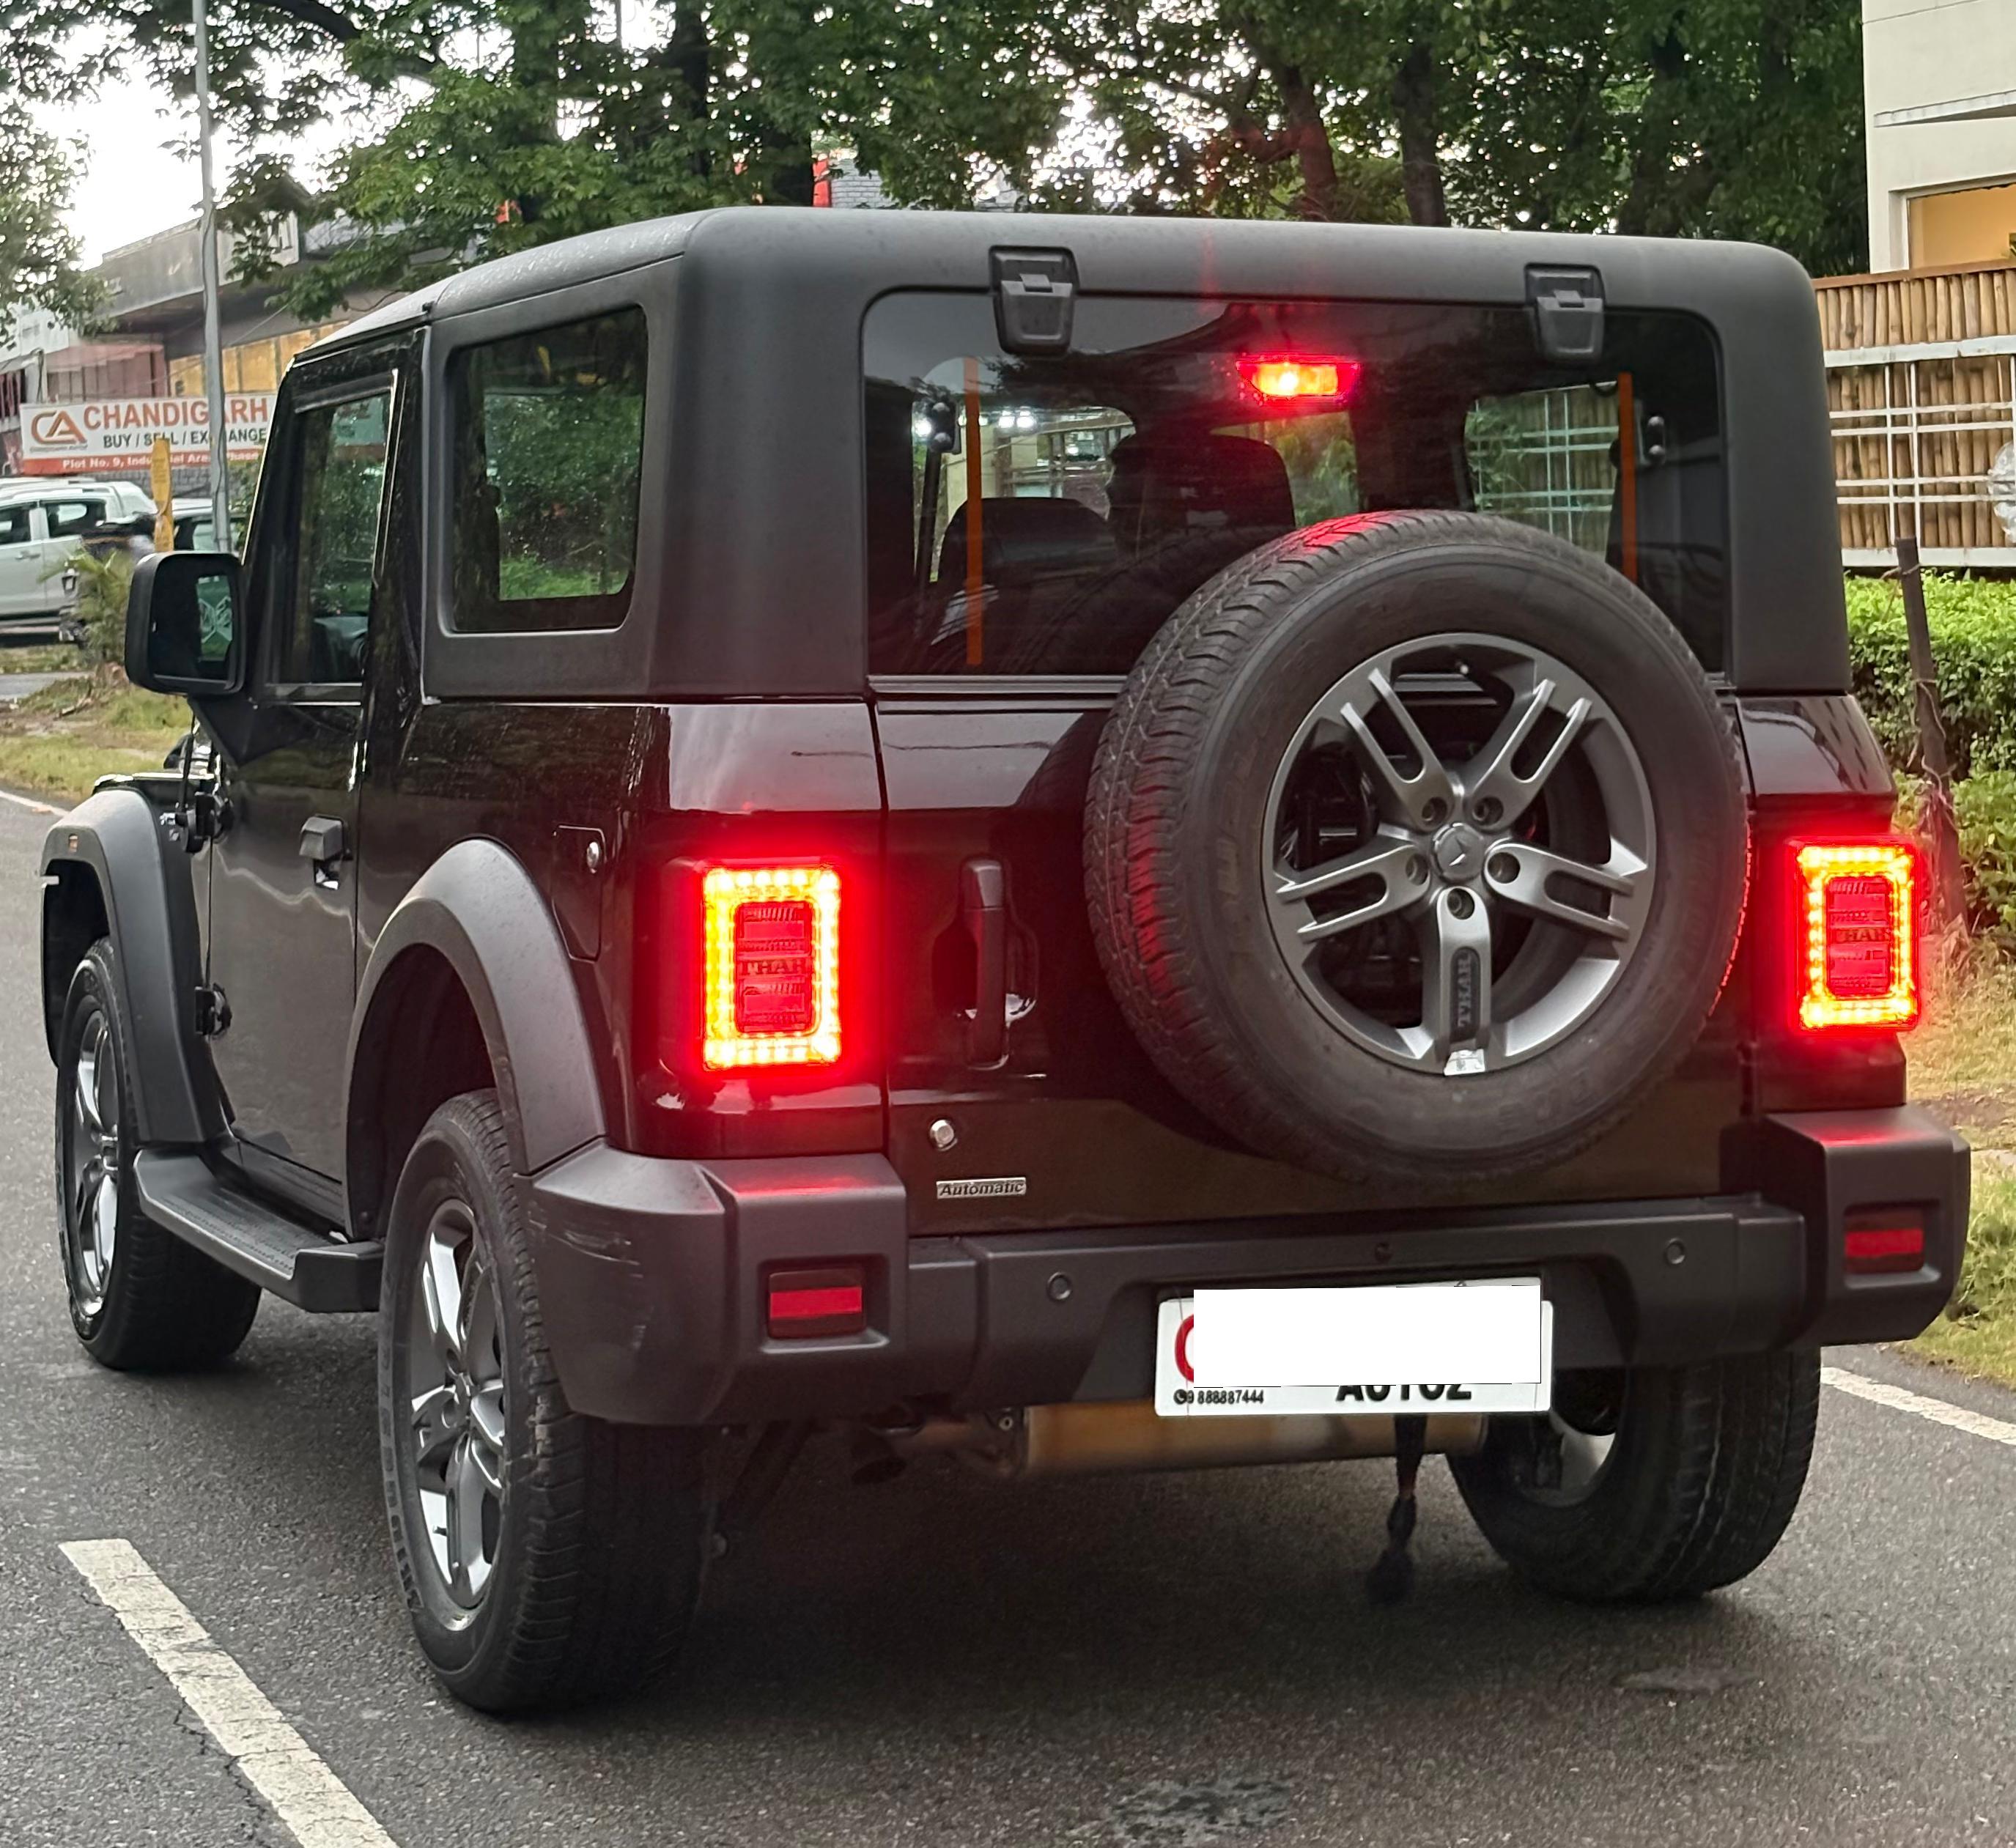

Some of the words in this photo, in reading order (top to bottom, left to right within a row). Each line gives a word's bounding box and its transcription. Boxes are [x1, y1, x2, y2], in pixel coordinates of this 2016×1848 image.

[84, 398, 268, 430] CHANDIGRH
[103, 433, 132, 448] BUY
[191, 427, 267, 445] EXANGE
[63, 458, 86, 468] Plot
[188, 453, 210, 464] Are
[939, 1182, 1024, 1196] Automatic
